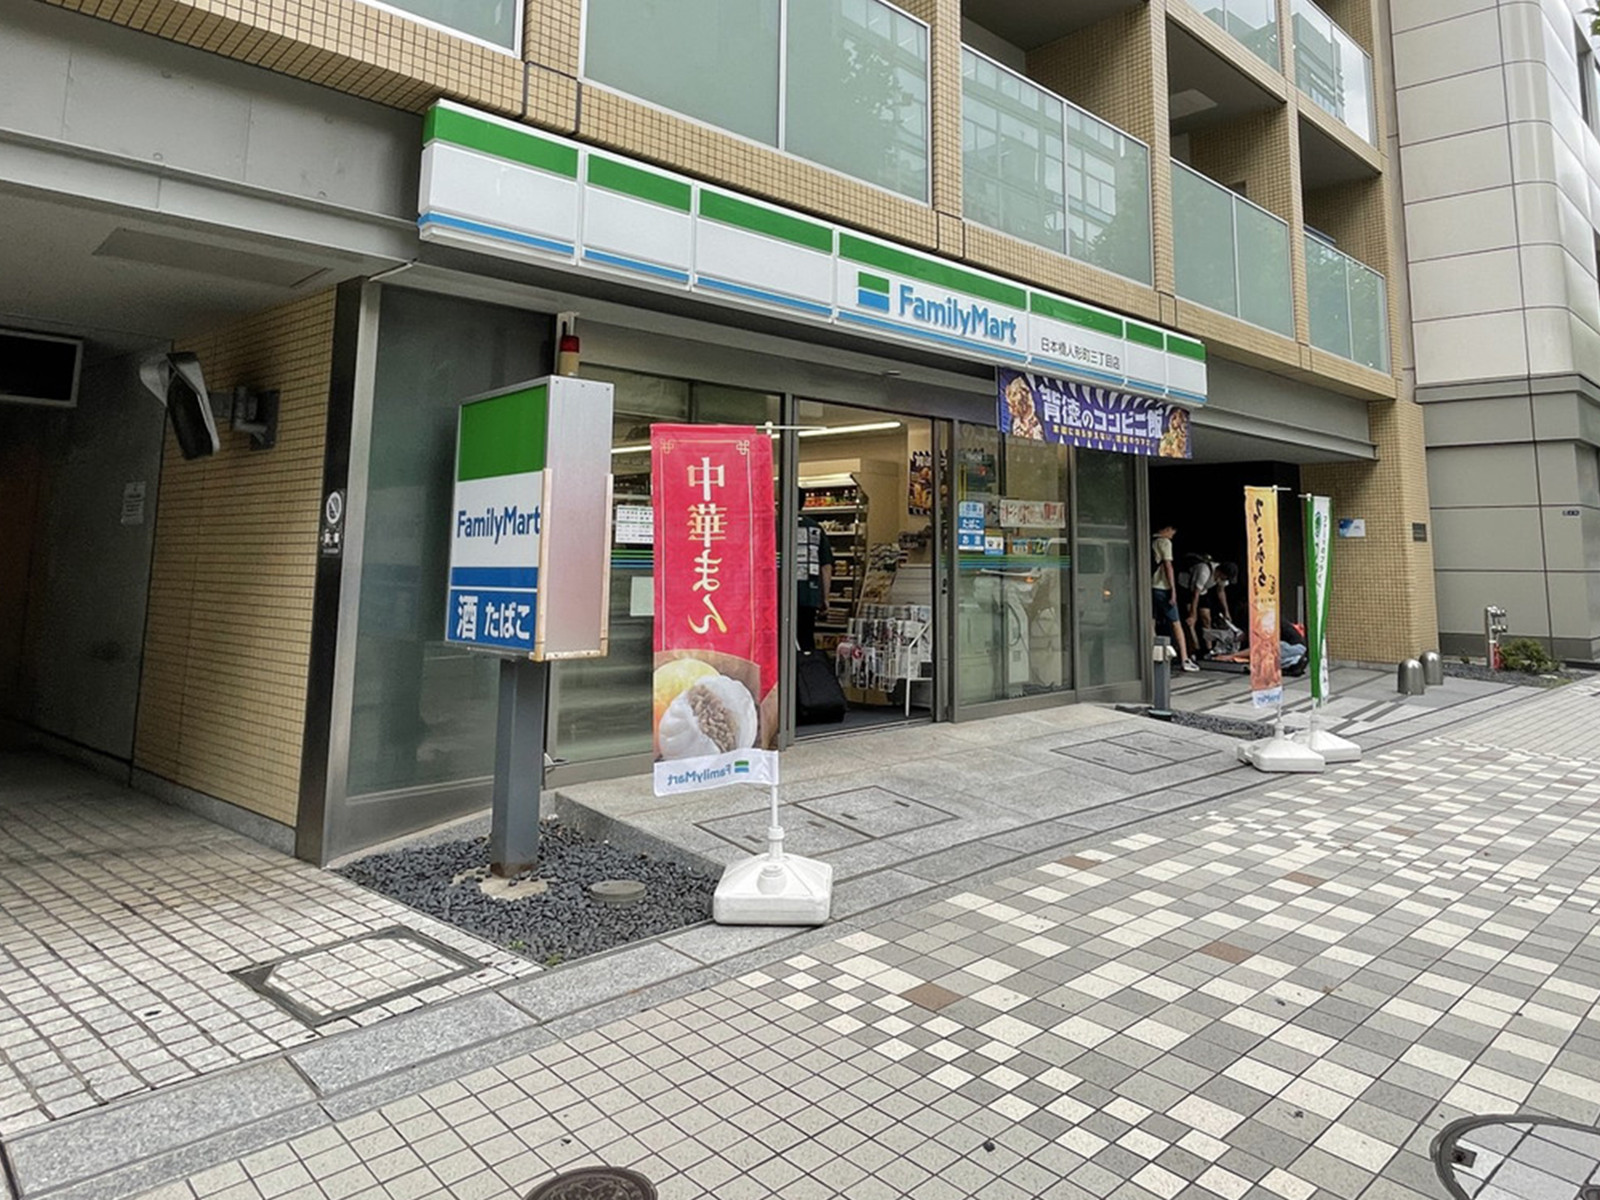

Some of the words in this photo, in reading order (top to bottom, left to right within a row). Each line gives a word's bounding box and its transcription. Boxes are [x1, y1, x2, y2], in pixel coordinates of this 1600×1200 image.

[899, 284, 1017, 345] FamilyMart
[1038, 384, 1164, 439] 背徳のコンビニ飯
[457, 506, 540, 545] FamilyMart
[686, 456, 728, 635] 中華まん
[457, 595, 478, 640] 酒
[484, 600, 531, 640] たばこ
